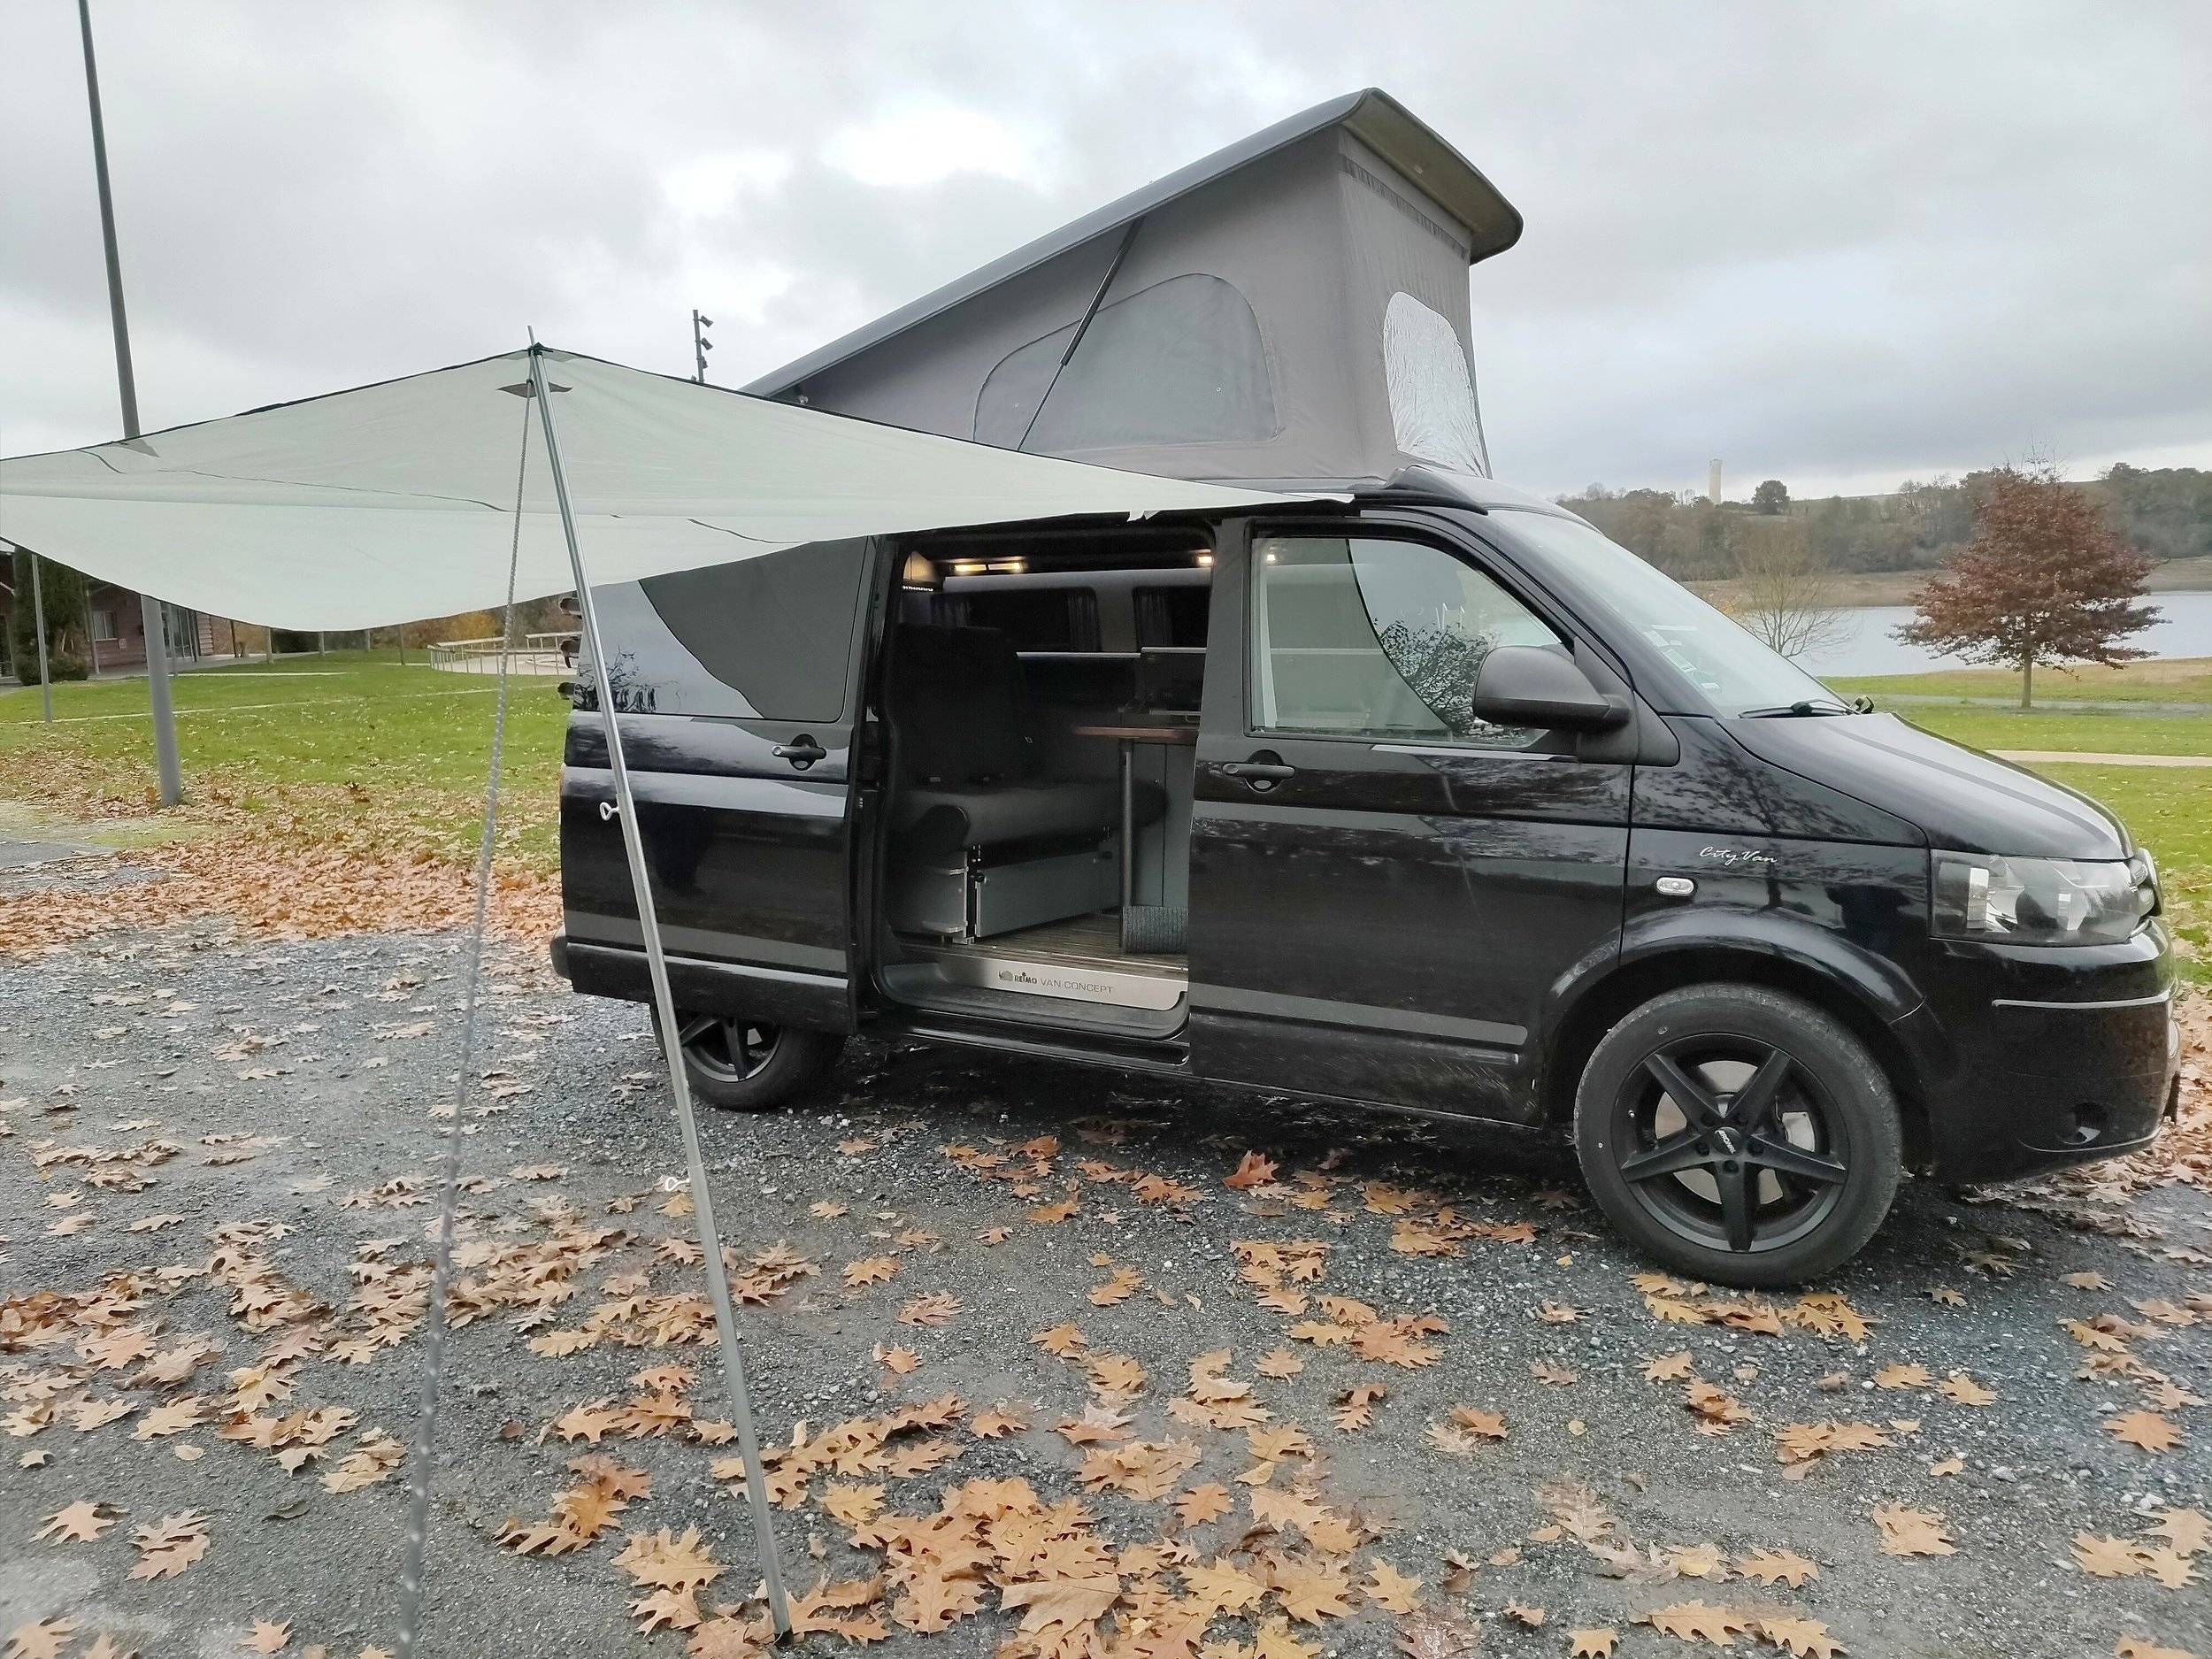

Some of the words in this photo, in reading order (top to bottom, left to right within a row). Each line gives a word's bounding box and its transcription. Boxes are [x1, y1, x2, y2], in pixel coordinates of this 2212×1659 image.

[1699, 846, 1738, 865] City
[1742, 851, 1778, 864] Van
[1041, 978, 1062, 989] VAN
[1064, 980, 1113, 994] CONCEPT
